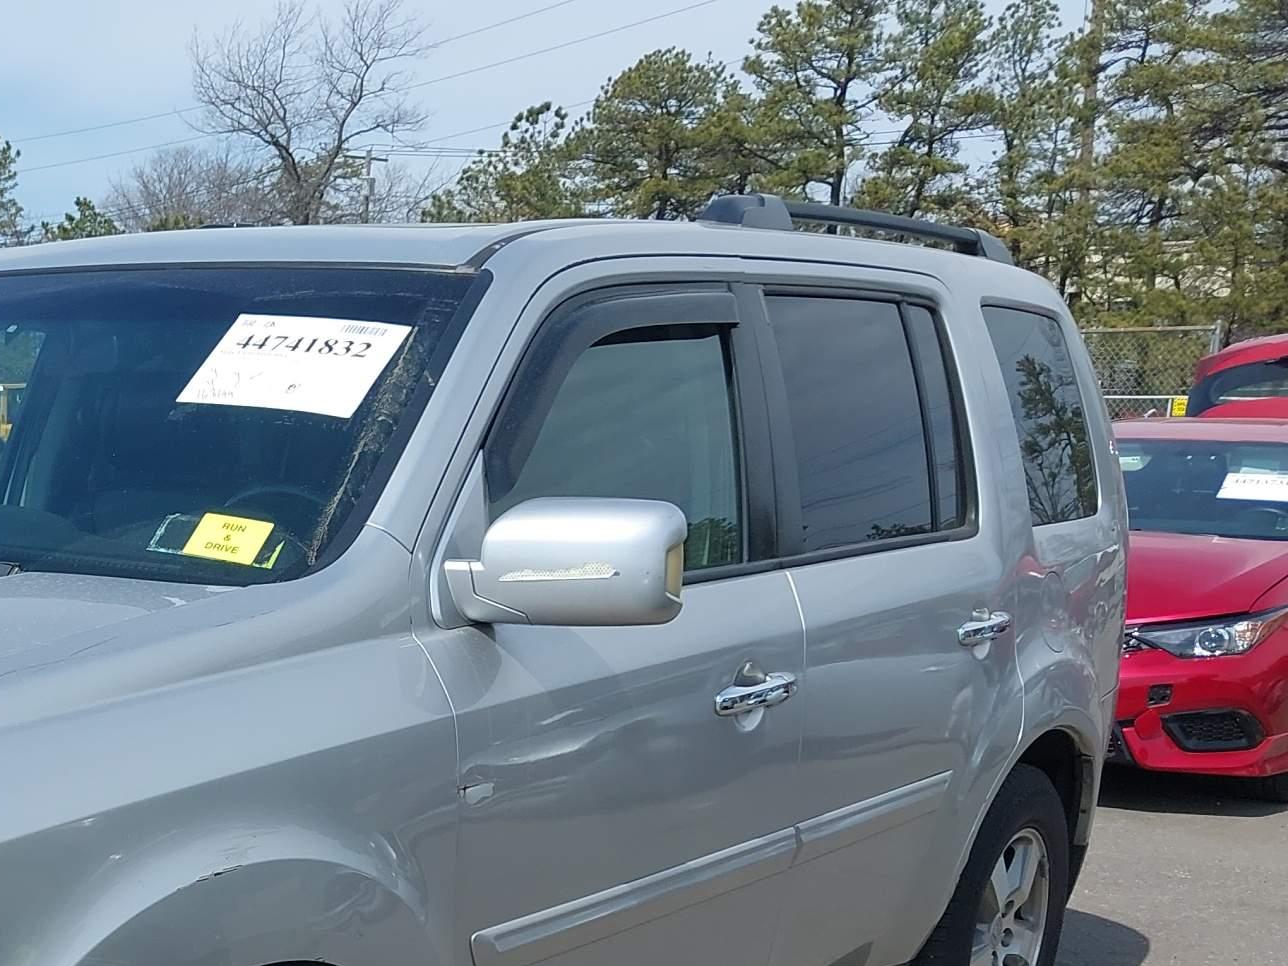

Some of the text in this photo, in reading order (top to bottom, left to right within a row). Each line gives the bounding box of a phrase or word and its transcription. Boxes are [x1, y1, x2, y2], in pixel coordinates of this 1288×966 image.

[236, 334, 373, 358] 44741832
[222, 523, 247, 532] RUN
[204, 542, 240, 553] DRIVE
